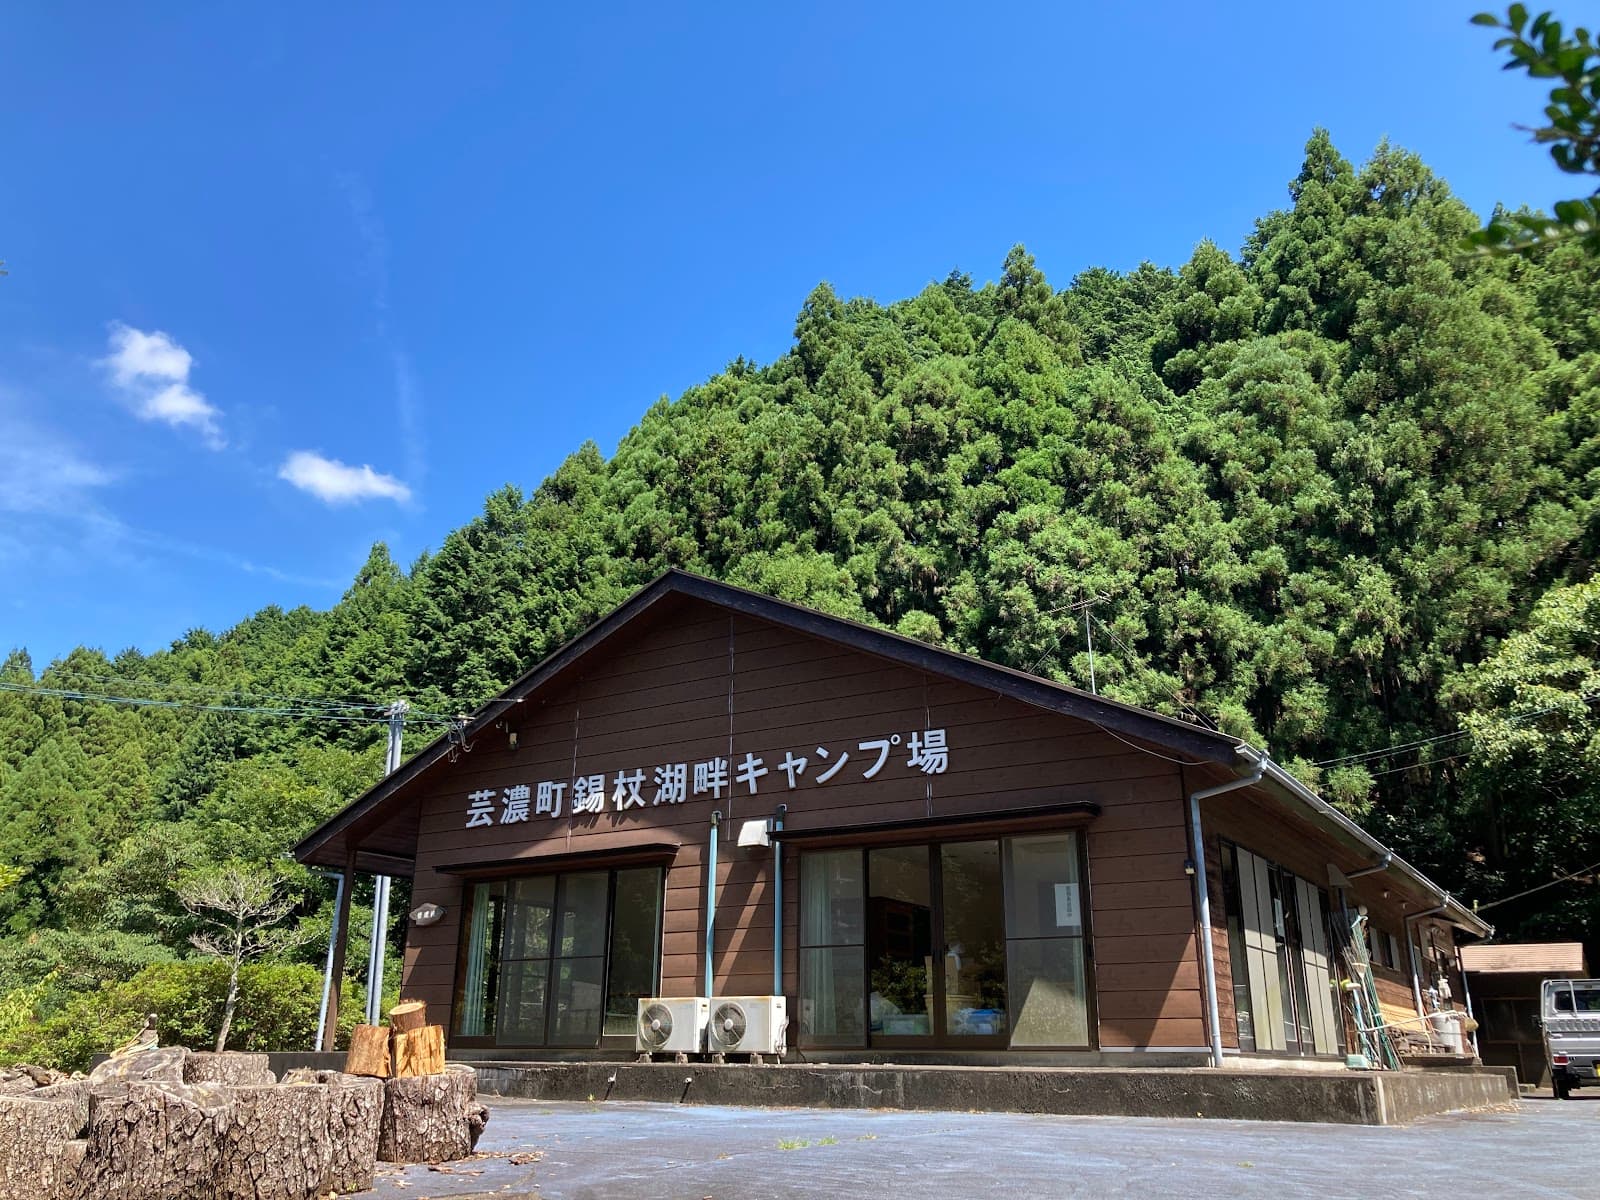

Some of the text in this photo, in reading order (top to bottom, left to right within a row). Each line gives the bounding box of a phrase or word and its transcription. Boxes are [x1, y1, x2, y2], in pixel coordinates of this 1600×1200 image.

[465, 728, 950, 828] 芸濃町錫杖湖畔キャンプ場
